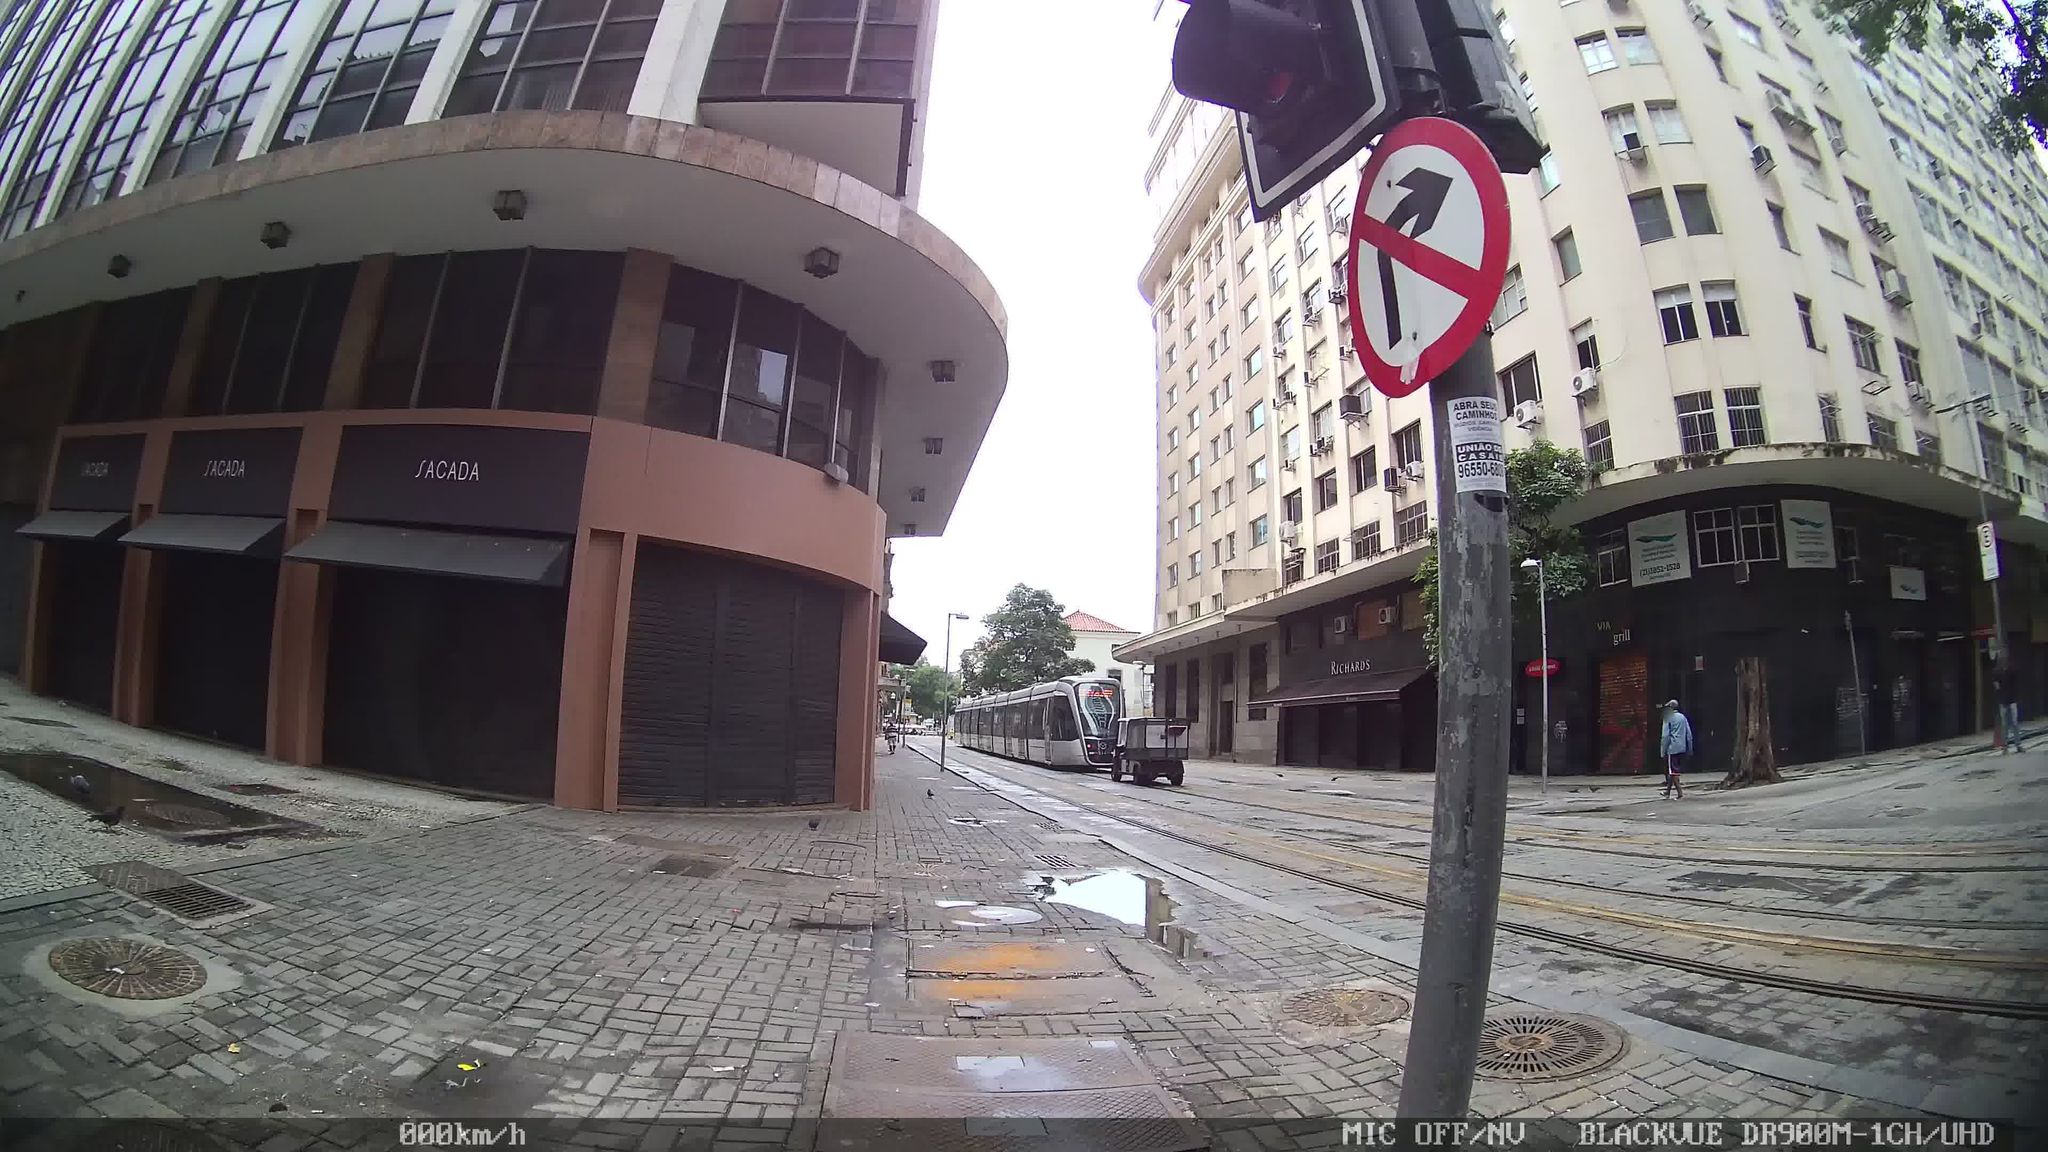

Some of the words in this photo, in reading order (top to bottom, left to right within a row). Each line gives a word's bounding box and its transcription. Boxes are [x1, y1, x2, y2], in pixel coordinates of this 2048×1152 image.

[1454, 401, 1478, 411] ABRA
[1457, 443, 1492, 453] UNIÃO
[204, 460, 246, 478] SACADA
[415, 459, 479, 481] SACADA
[1613, 629, 1630, 646] grill
[1331, 660, 1371, 675] RICHARDS
